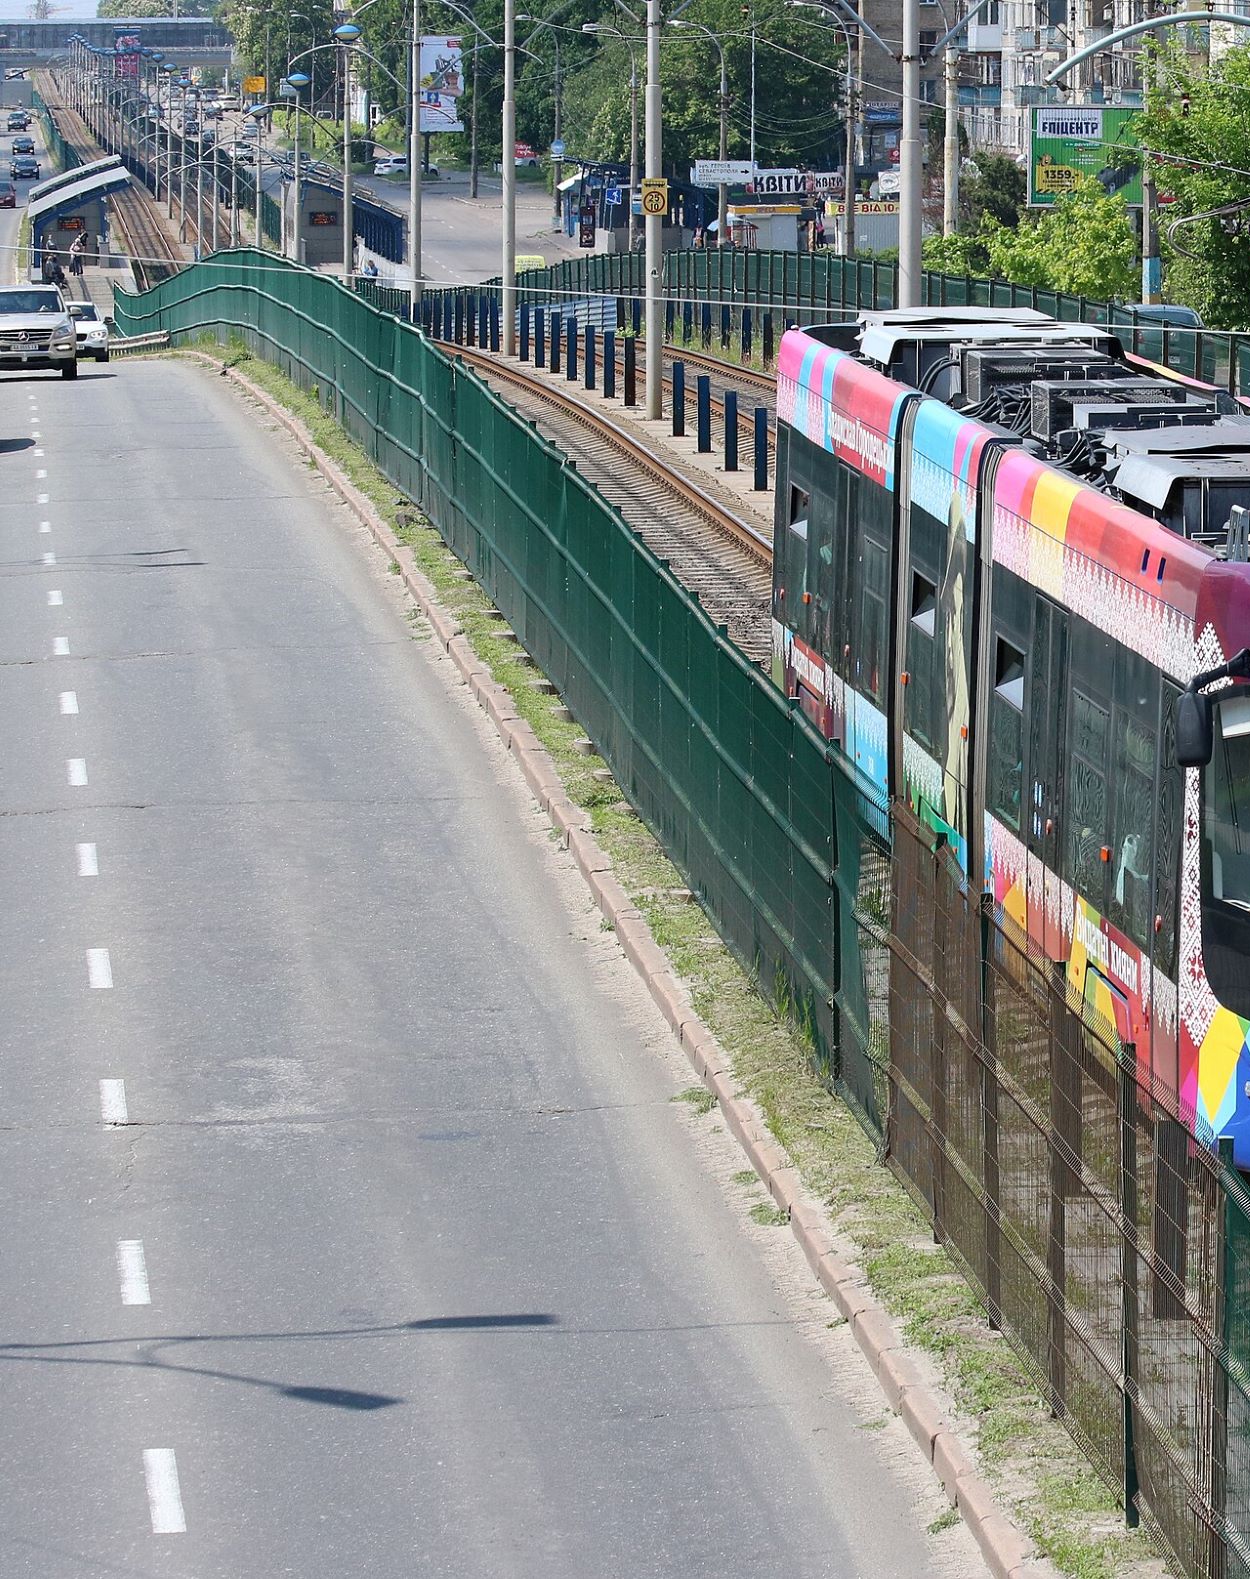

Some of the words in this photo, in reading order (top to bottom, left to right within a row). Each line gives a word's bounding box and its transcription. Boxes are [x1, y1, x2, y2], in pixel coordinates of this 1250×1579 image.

[1042, 122, 1098, 135] ЕПІЦЕНТР
[754, 175, 806, 193] КВІТИ
[815, 176, 844, 188] КВІТИ
[649, 194, 660, 202] 25
